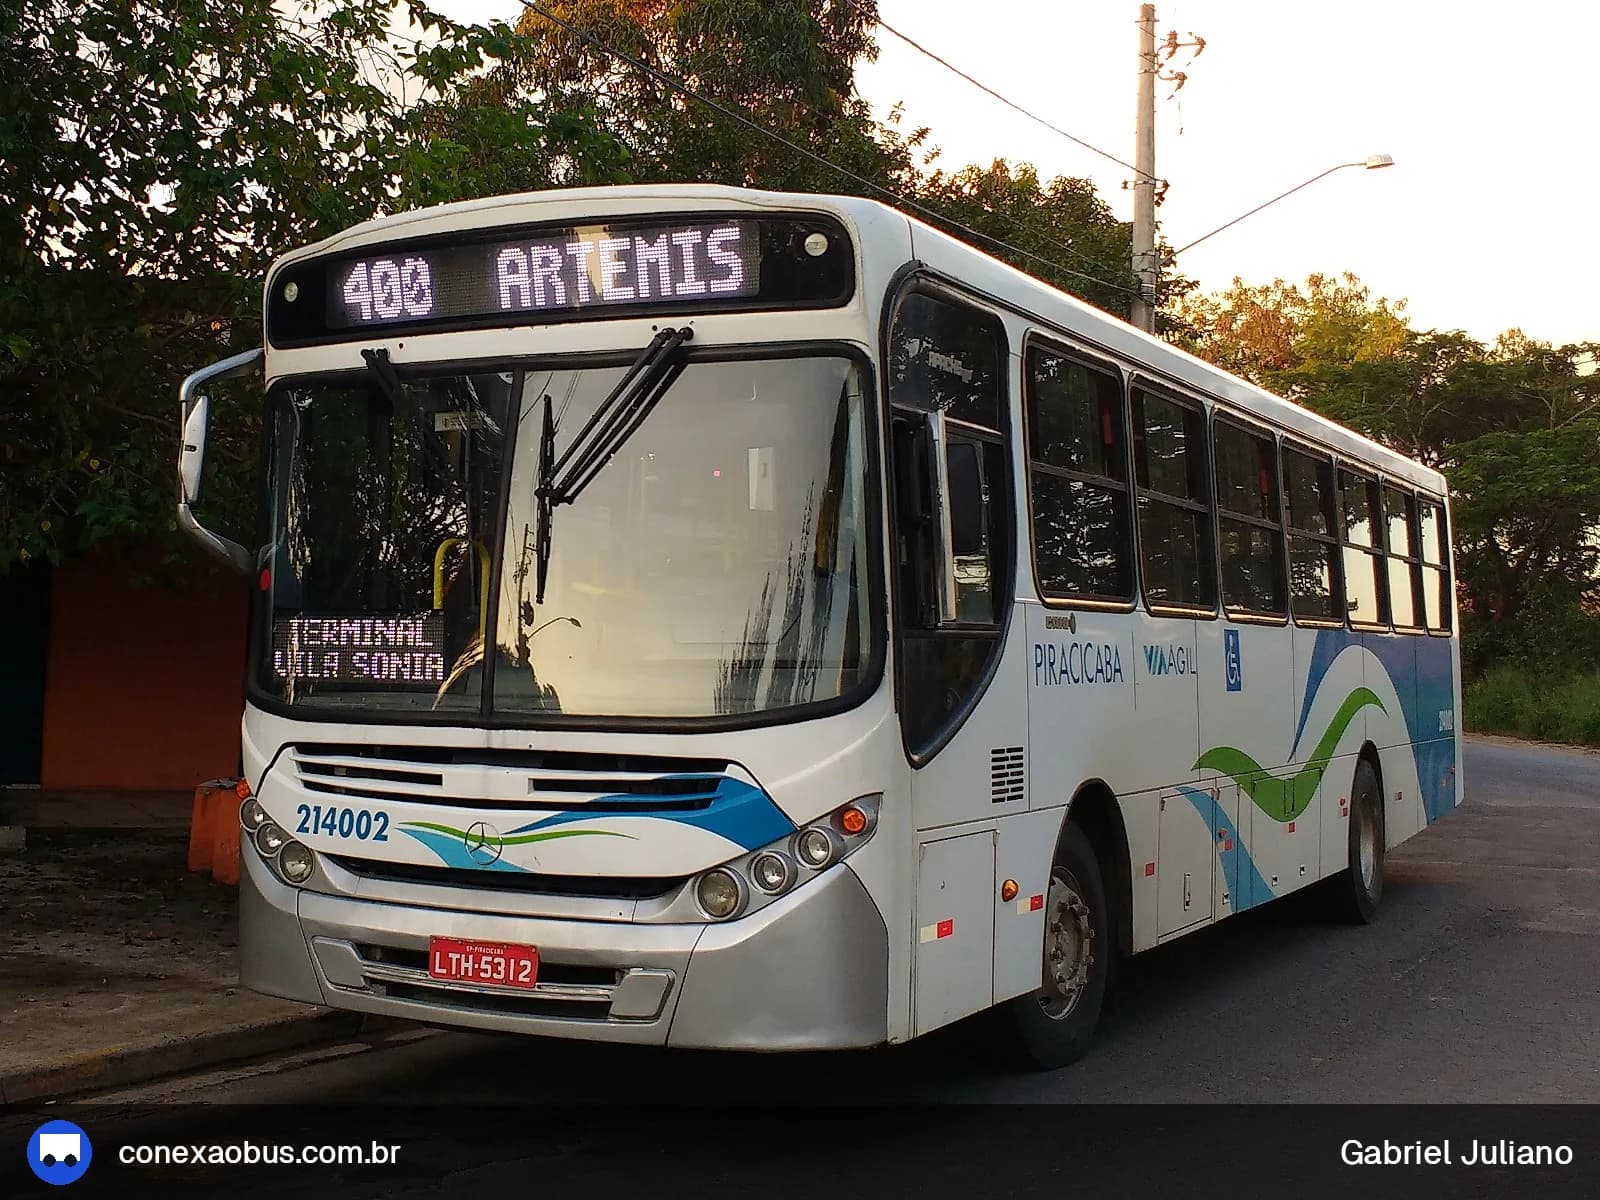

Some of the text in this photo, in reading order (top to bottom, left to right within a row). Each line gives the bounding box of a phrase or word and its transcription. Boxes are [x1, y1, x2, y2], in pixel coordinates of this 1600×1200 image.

[342, 226, 743, 322] 400 ARTEMIS
[289, 618, 434, 646] TERMINAL
[351, 652, 444, 680] SONIA
[1034, 642, 1124, 686] PIRACICABA
[295, 803, 390, 841] 214002
